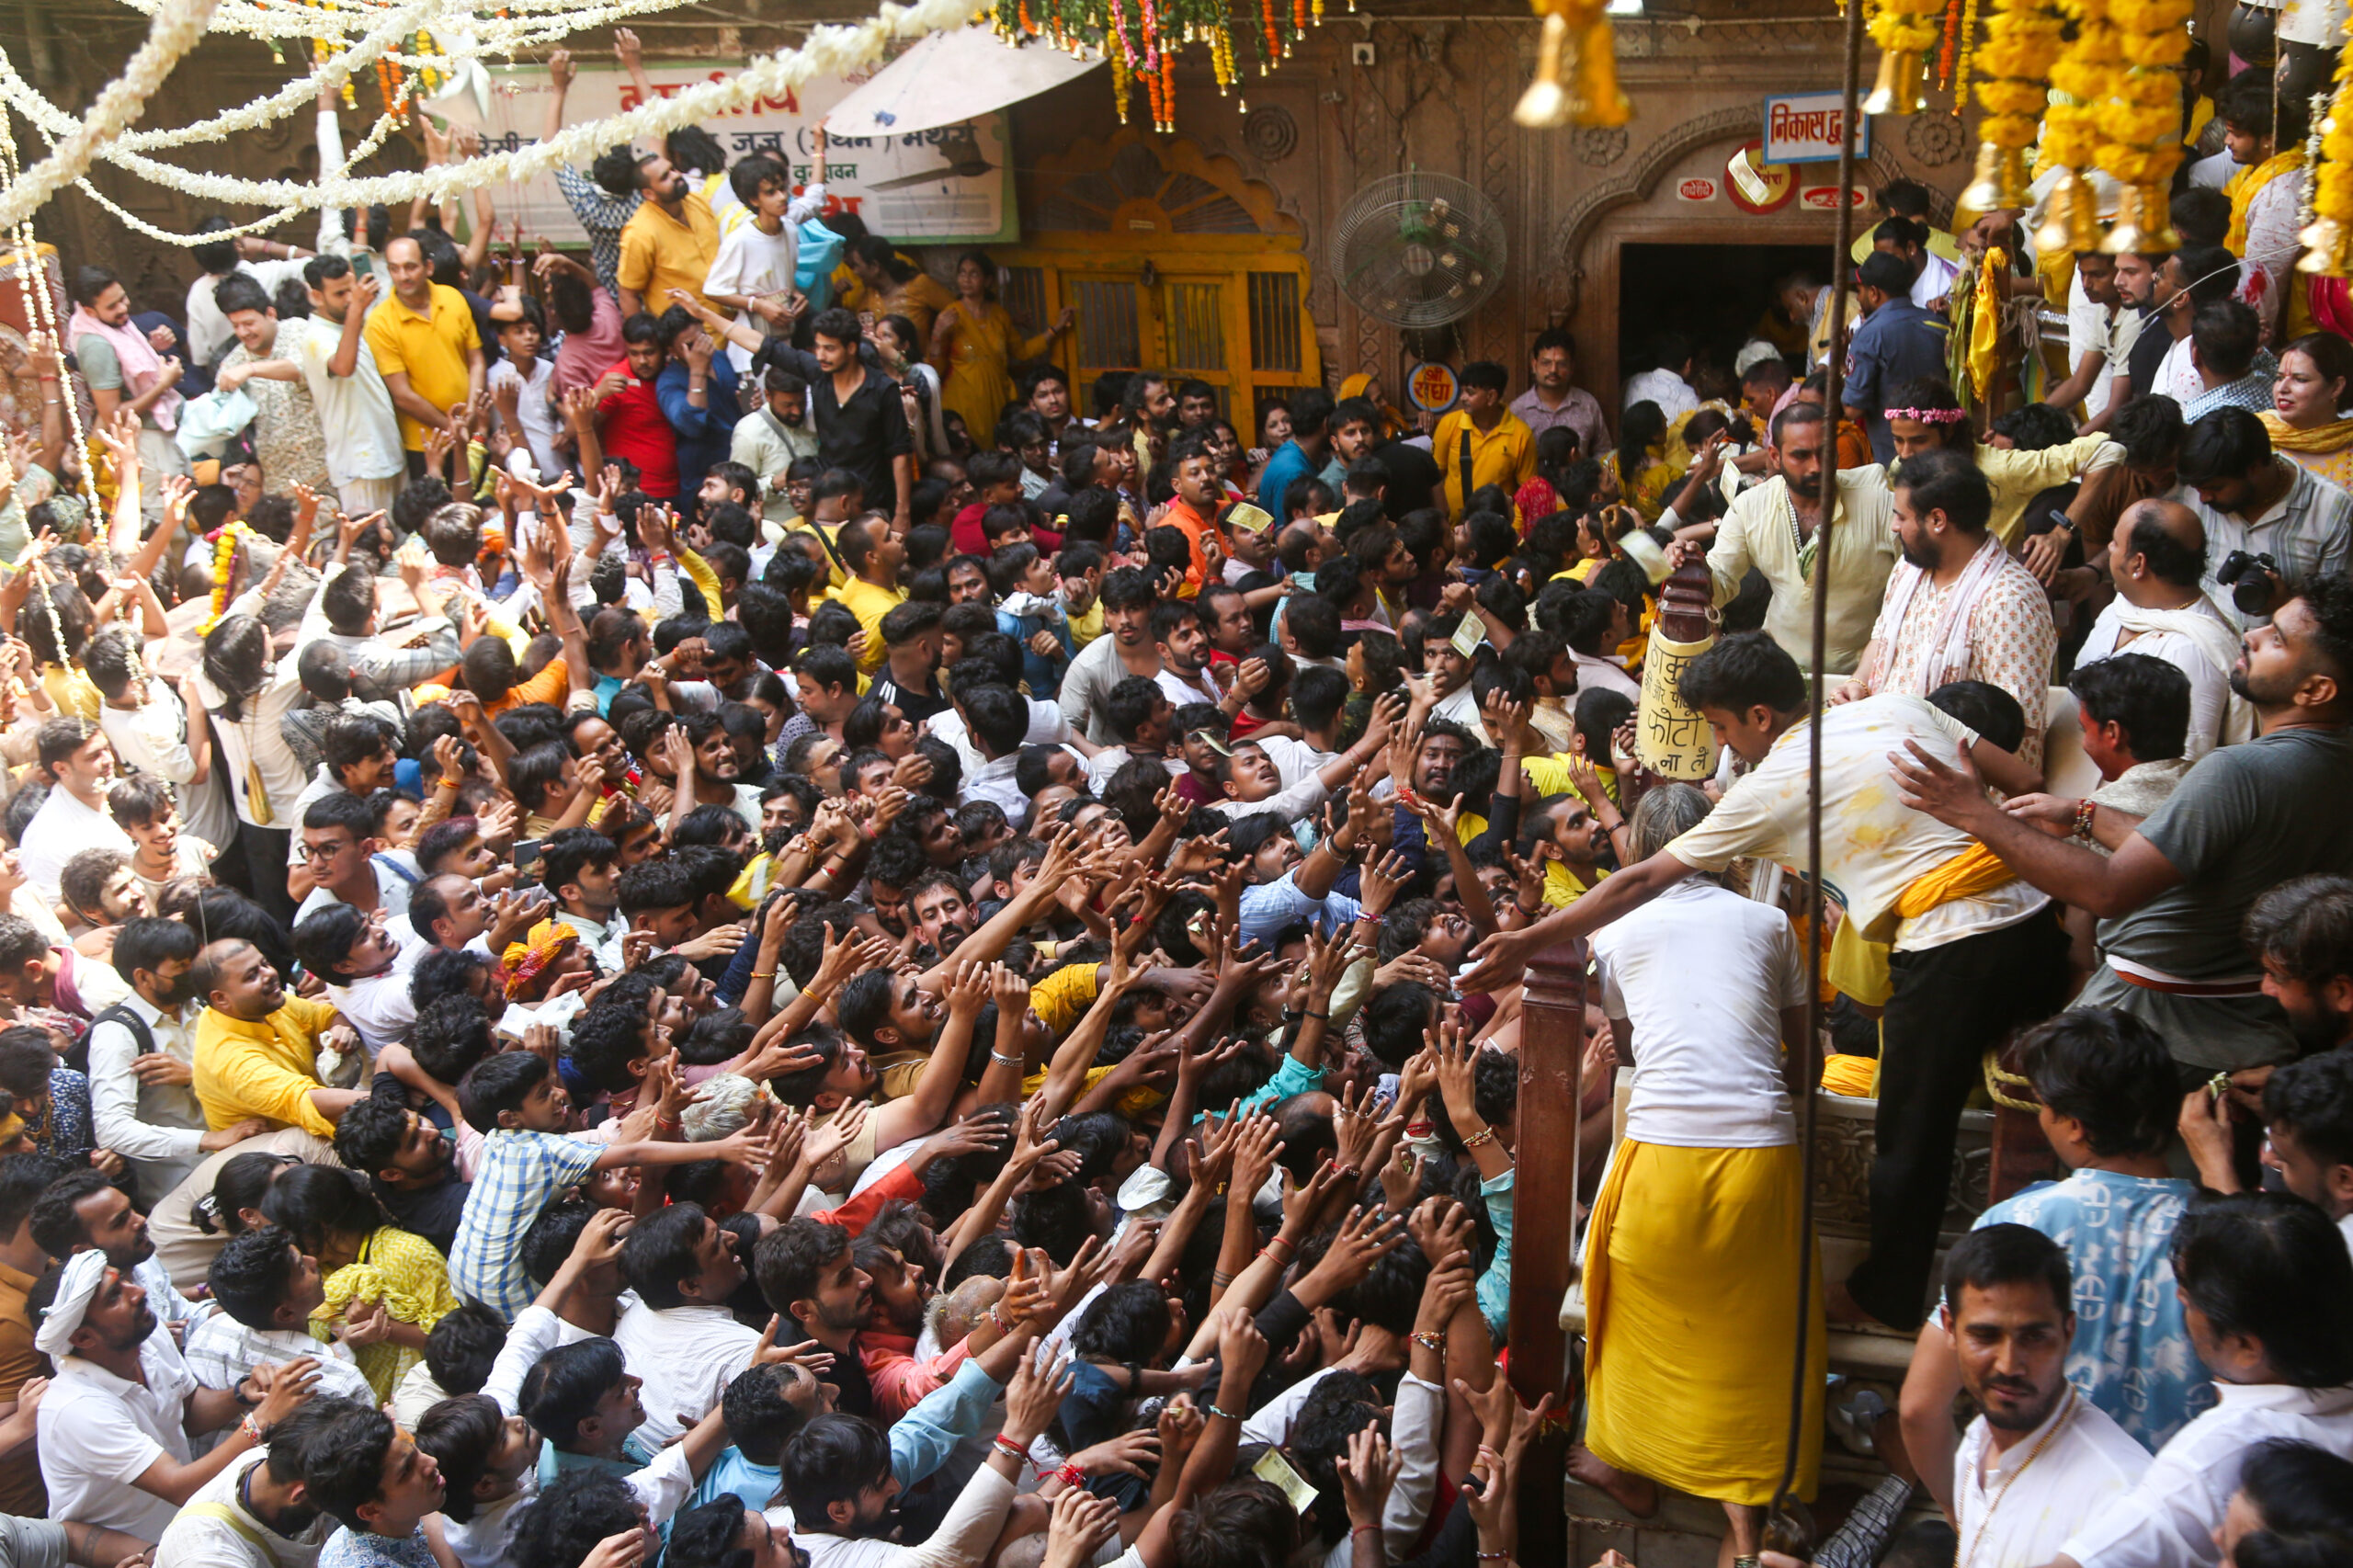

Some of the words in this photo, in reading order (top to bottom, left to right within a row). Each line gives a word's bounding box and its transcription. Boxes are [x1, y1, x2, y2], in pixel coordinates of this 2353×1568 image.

[1770, 103, 1826, 143] निकास
[1647, 707, 1704, 747] फोटो
[1660, 754, 1682, 772] ना
